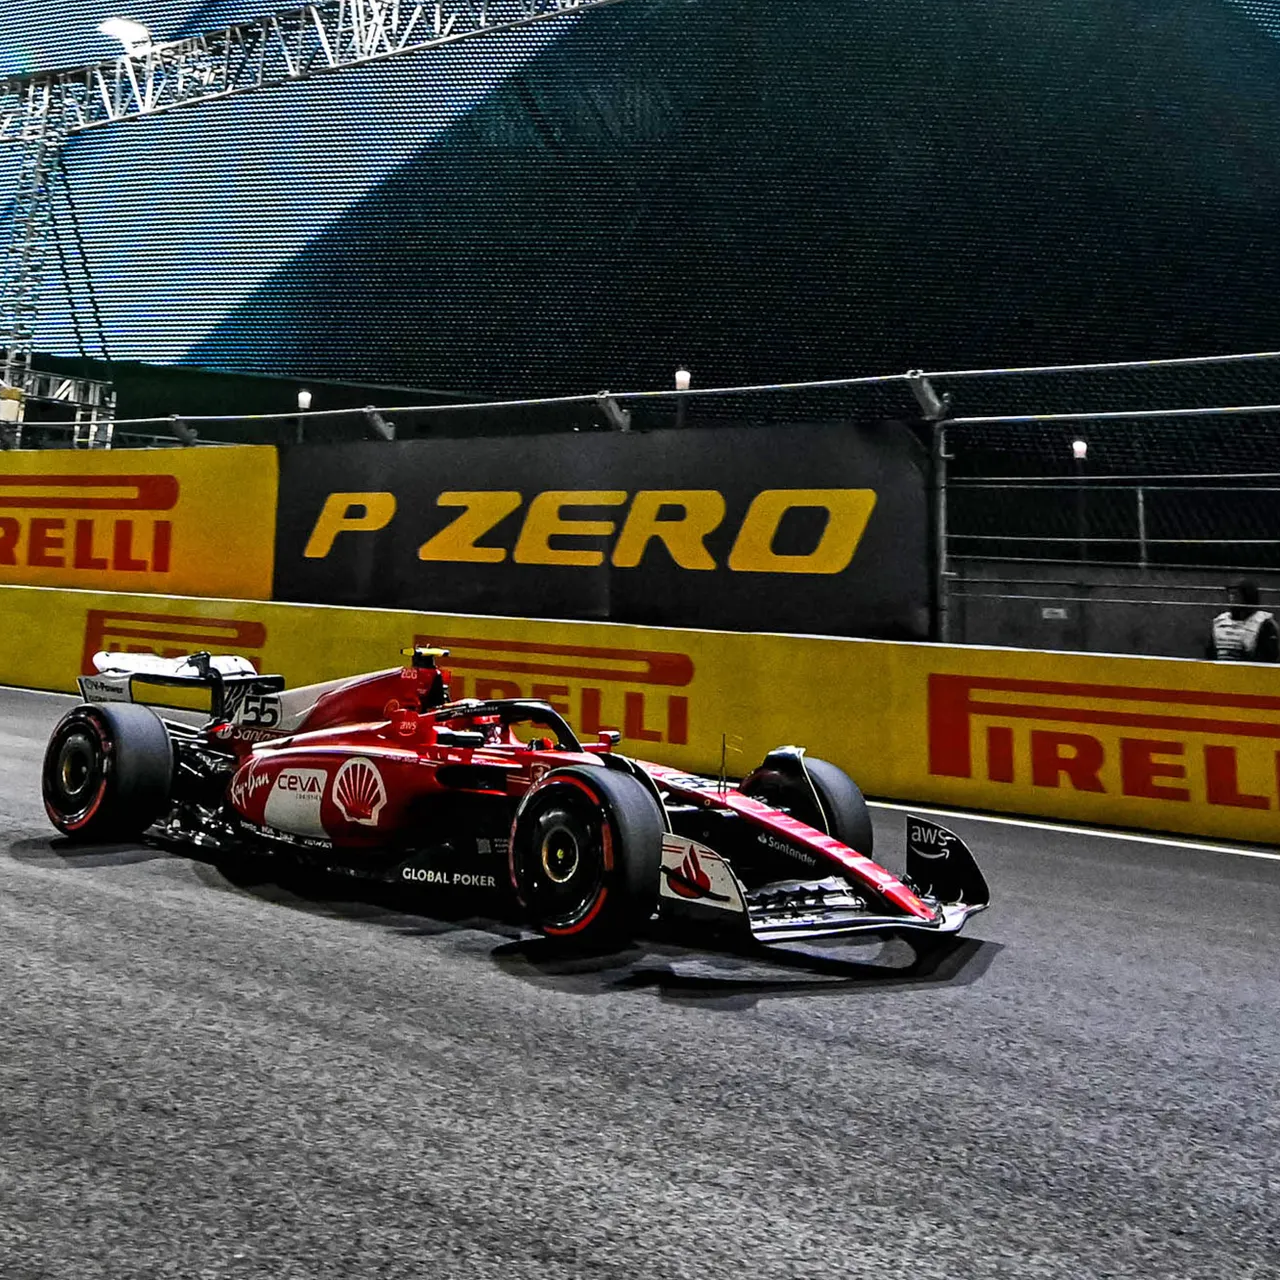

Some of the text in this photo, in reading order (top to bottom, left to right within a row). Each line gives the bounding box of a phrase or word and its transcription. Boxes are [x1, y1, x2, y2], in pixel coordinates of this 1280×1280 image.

[303, 488, 878, 575] P ZERO
[241, 695, 279, 728] 55
[768, 836, 817, 867] Santander
[911, 825, 948, 847] aws
[402, 867, 496, 887] GLOBAL POKER
